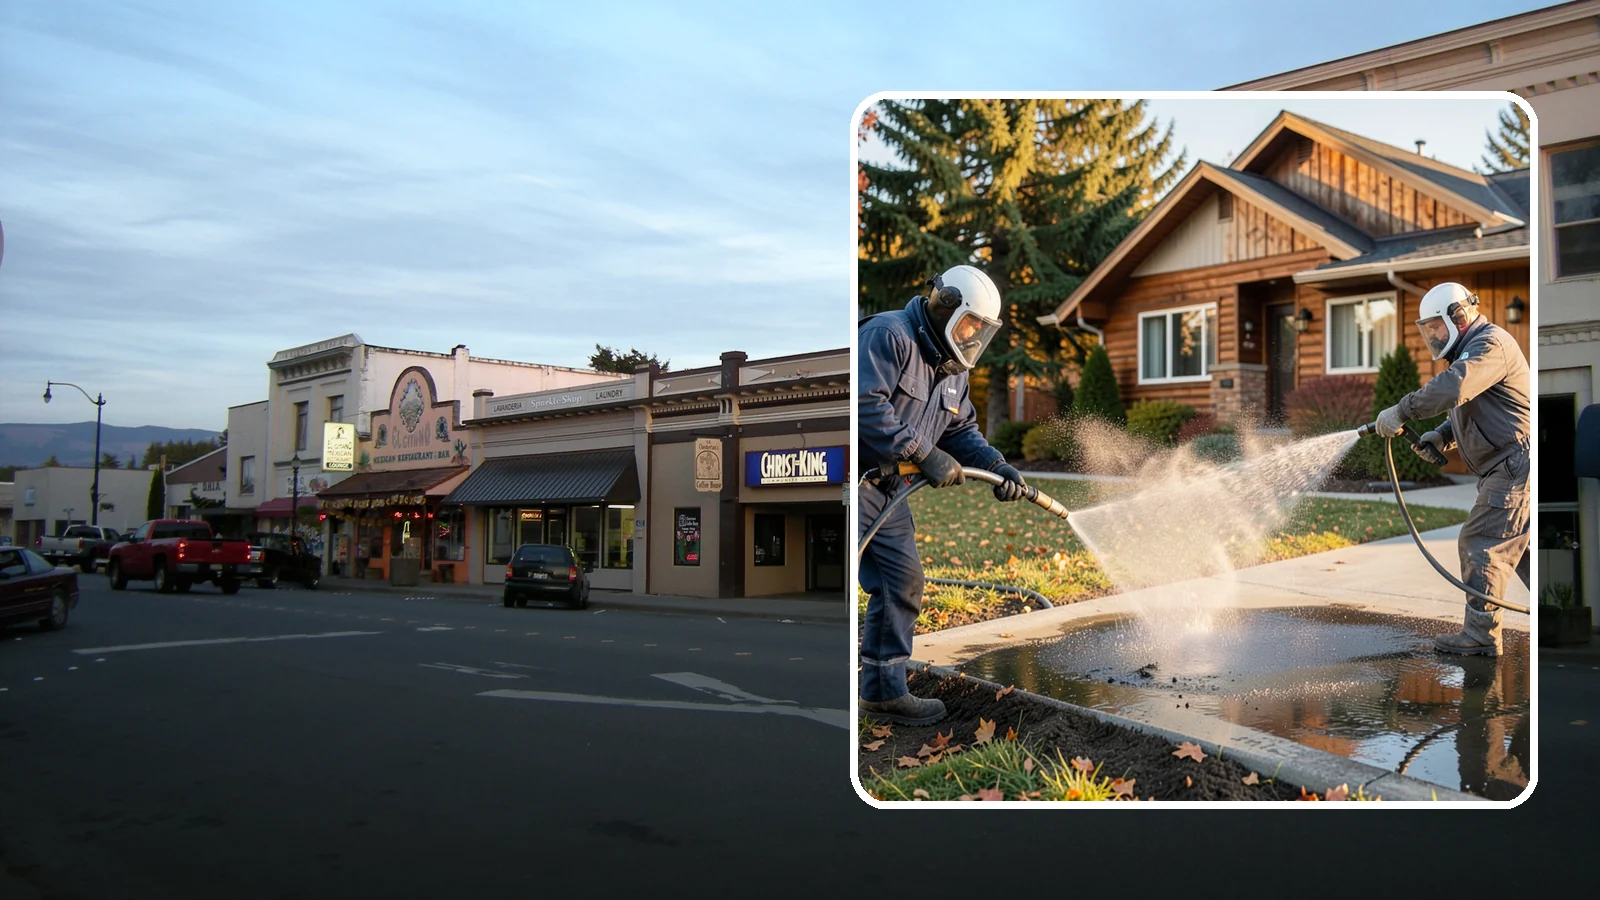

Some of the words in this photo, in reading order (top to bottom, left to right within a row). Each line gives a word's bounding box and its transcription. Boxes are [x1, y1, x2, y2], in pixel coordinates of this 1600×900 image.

[595, 388, 624, 400] LAUNDRY
[493, 402, 523, 413] LAVANDERIA
[530, 397, 561, 409] Sparkle
[562, 394, 583, 405] Shop
[398, 451, 433, 462] RESTAURANT
[438, 450, 450, 459] BAR
